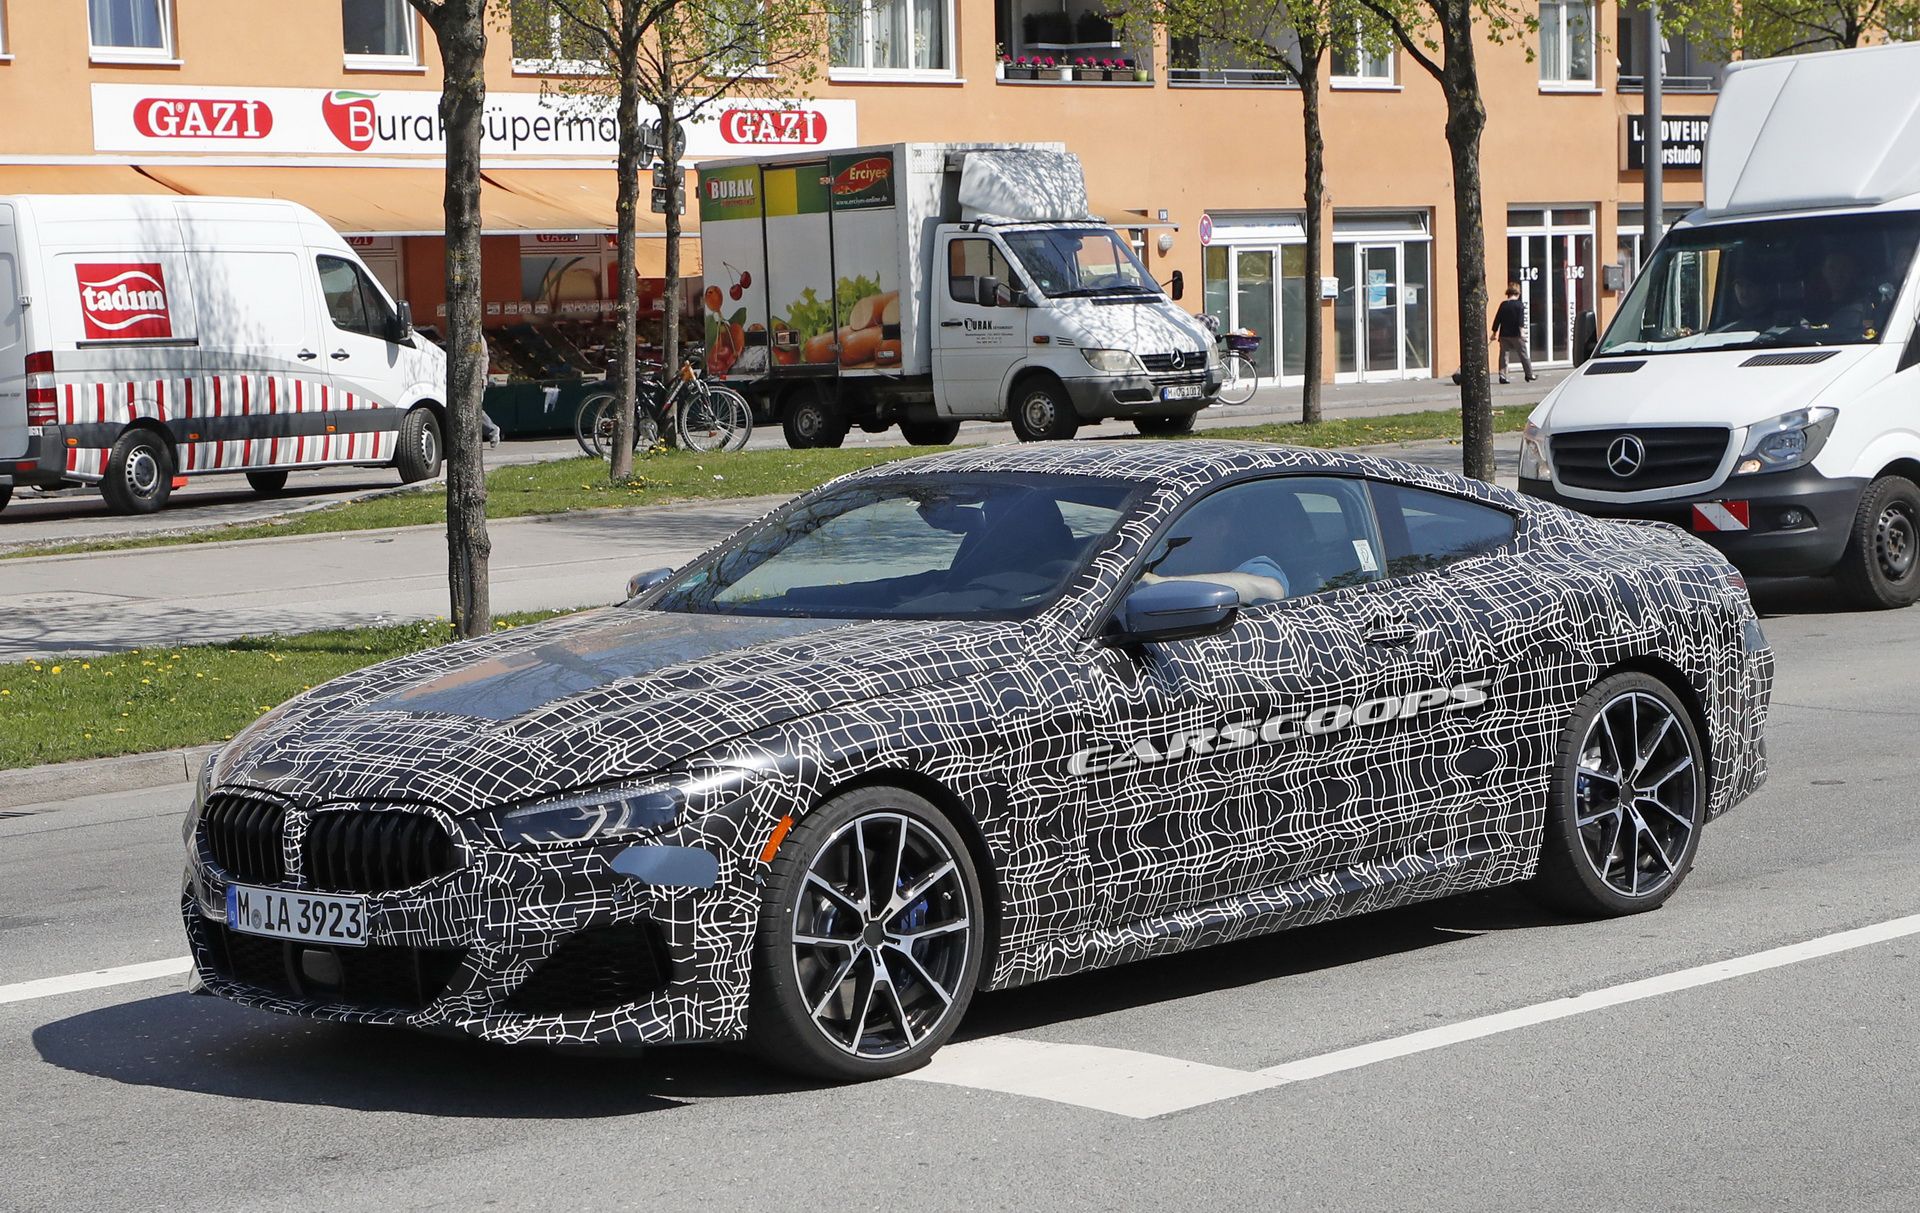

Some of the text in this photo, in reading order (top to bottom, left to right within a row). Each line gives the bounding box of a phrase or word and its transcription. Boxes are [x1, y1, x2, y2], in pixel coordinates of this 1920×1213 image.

[850, 164, 887, 182] Erciyes
[711, 179, 754, 199] BURAK
[1519, 267, 1538, 280] 11€
[1566, 266, 1584, 279] 15€
[237, 890, 361, 938] M IA 3923
